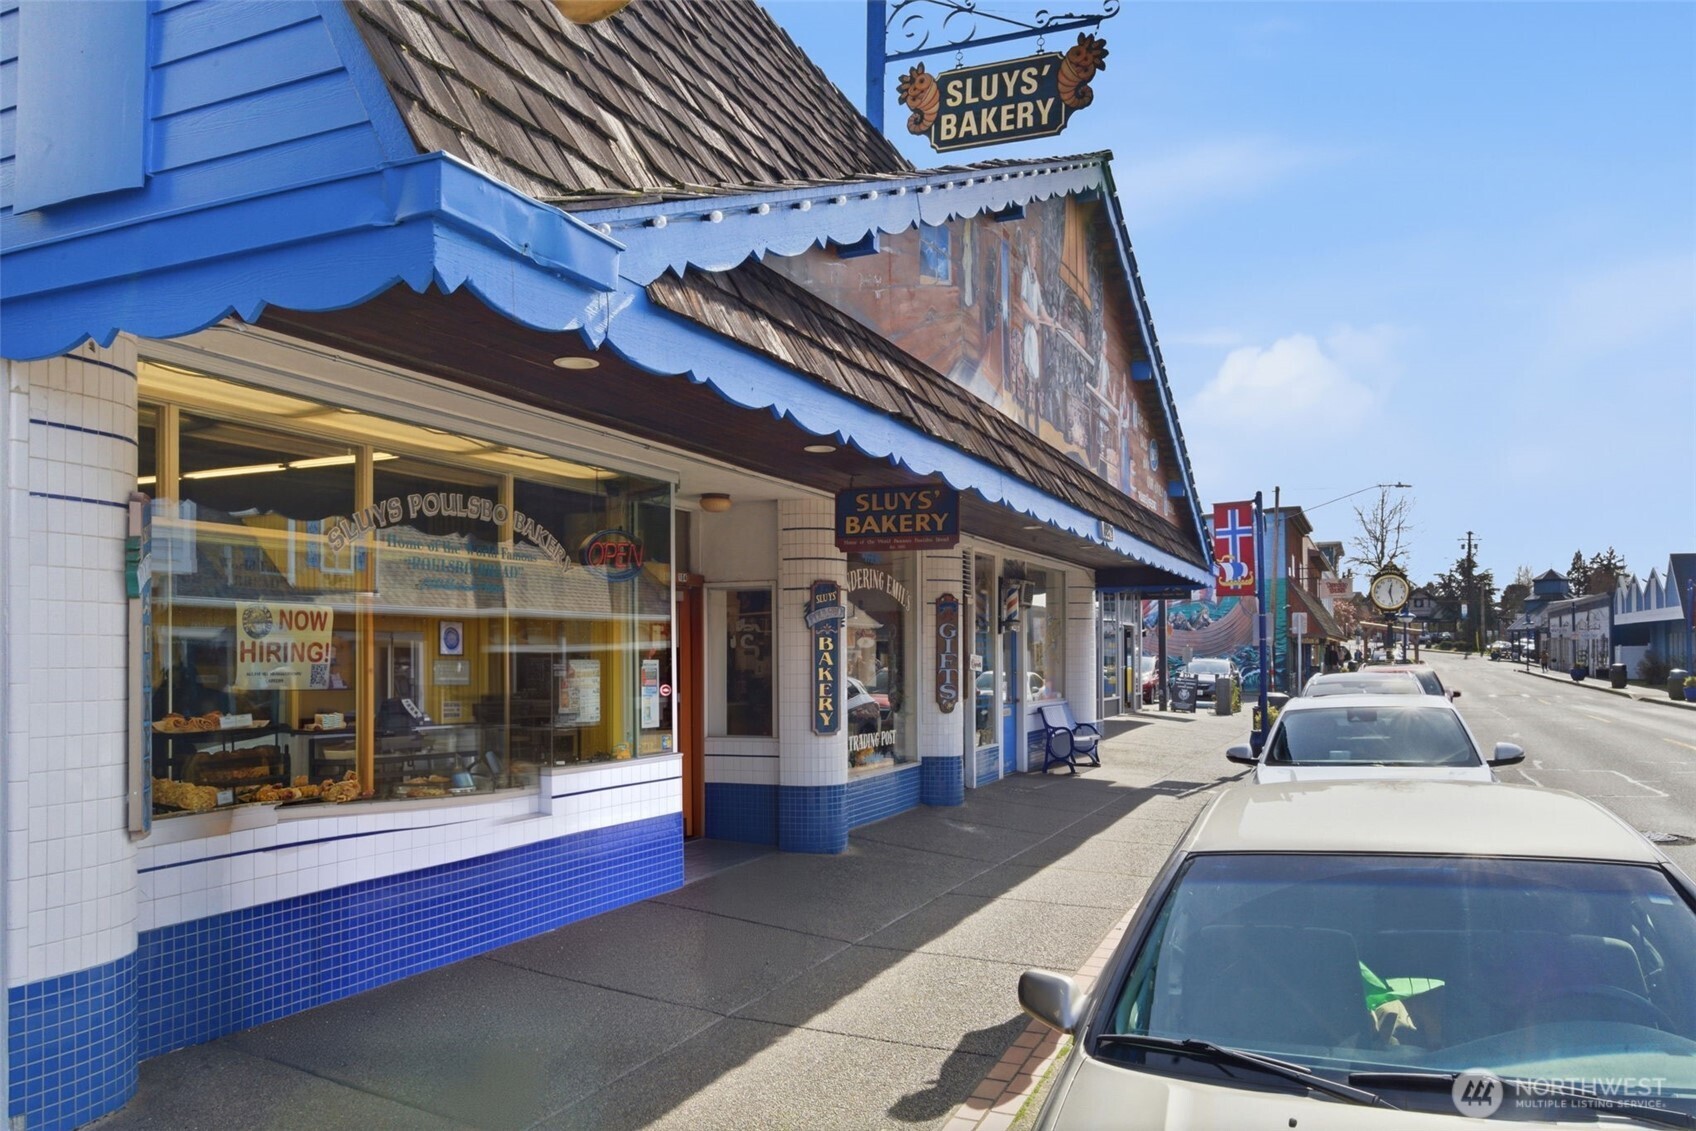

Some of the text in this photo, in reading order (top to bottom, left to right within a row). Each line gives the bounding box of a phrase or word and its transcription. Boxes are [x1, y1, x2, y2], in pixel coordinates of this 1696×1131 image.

[946, 64, 1052, 107] SLUYS'
[940, 97, 1055, 141] BAKERY
[855, 489, 940, 512] SLUYS'
[327, 492, 575, 574] SLUYS POULSBO BAKERY
[845, 512, 949, 535] BAKERY
[587, 540, 645, 569] OPEN
[278, 609, 328, 632] NOW
[239, 640, 330, 663] HIRING!
[938, 622, 959, 700] GIFTS
[818, 637, 834, 726] BAKERY
[848, 729, 897, 751] TRADING POST
